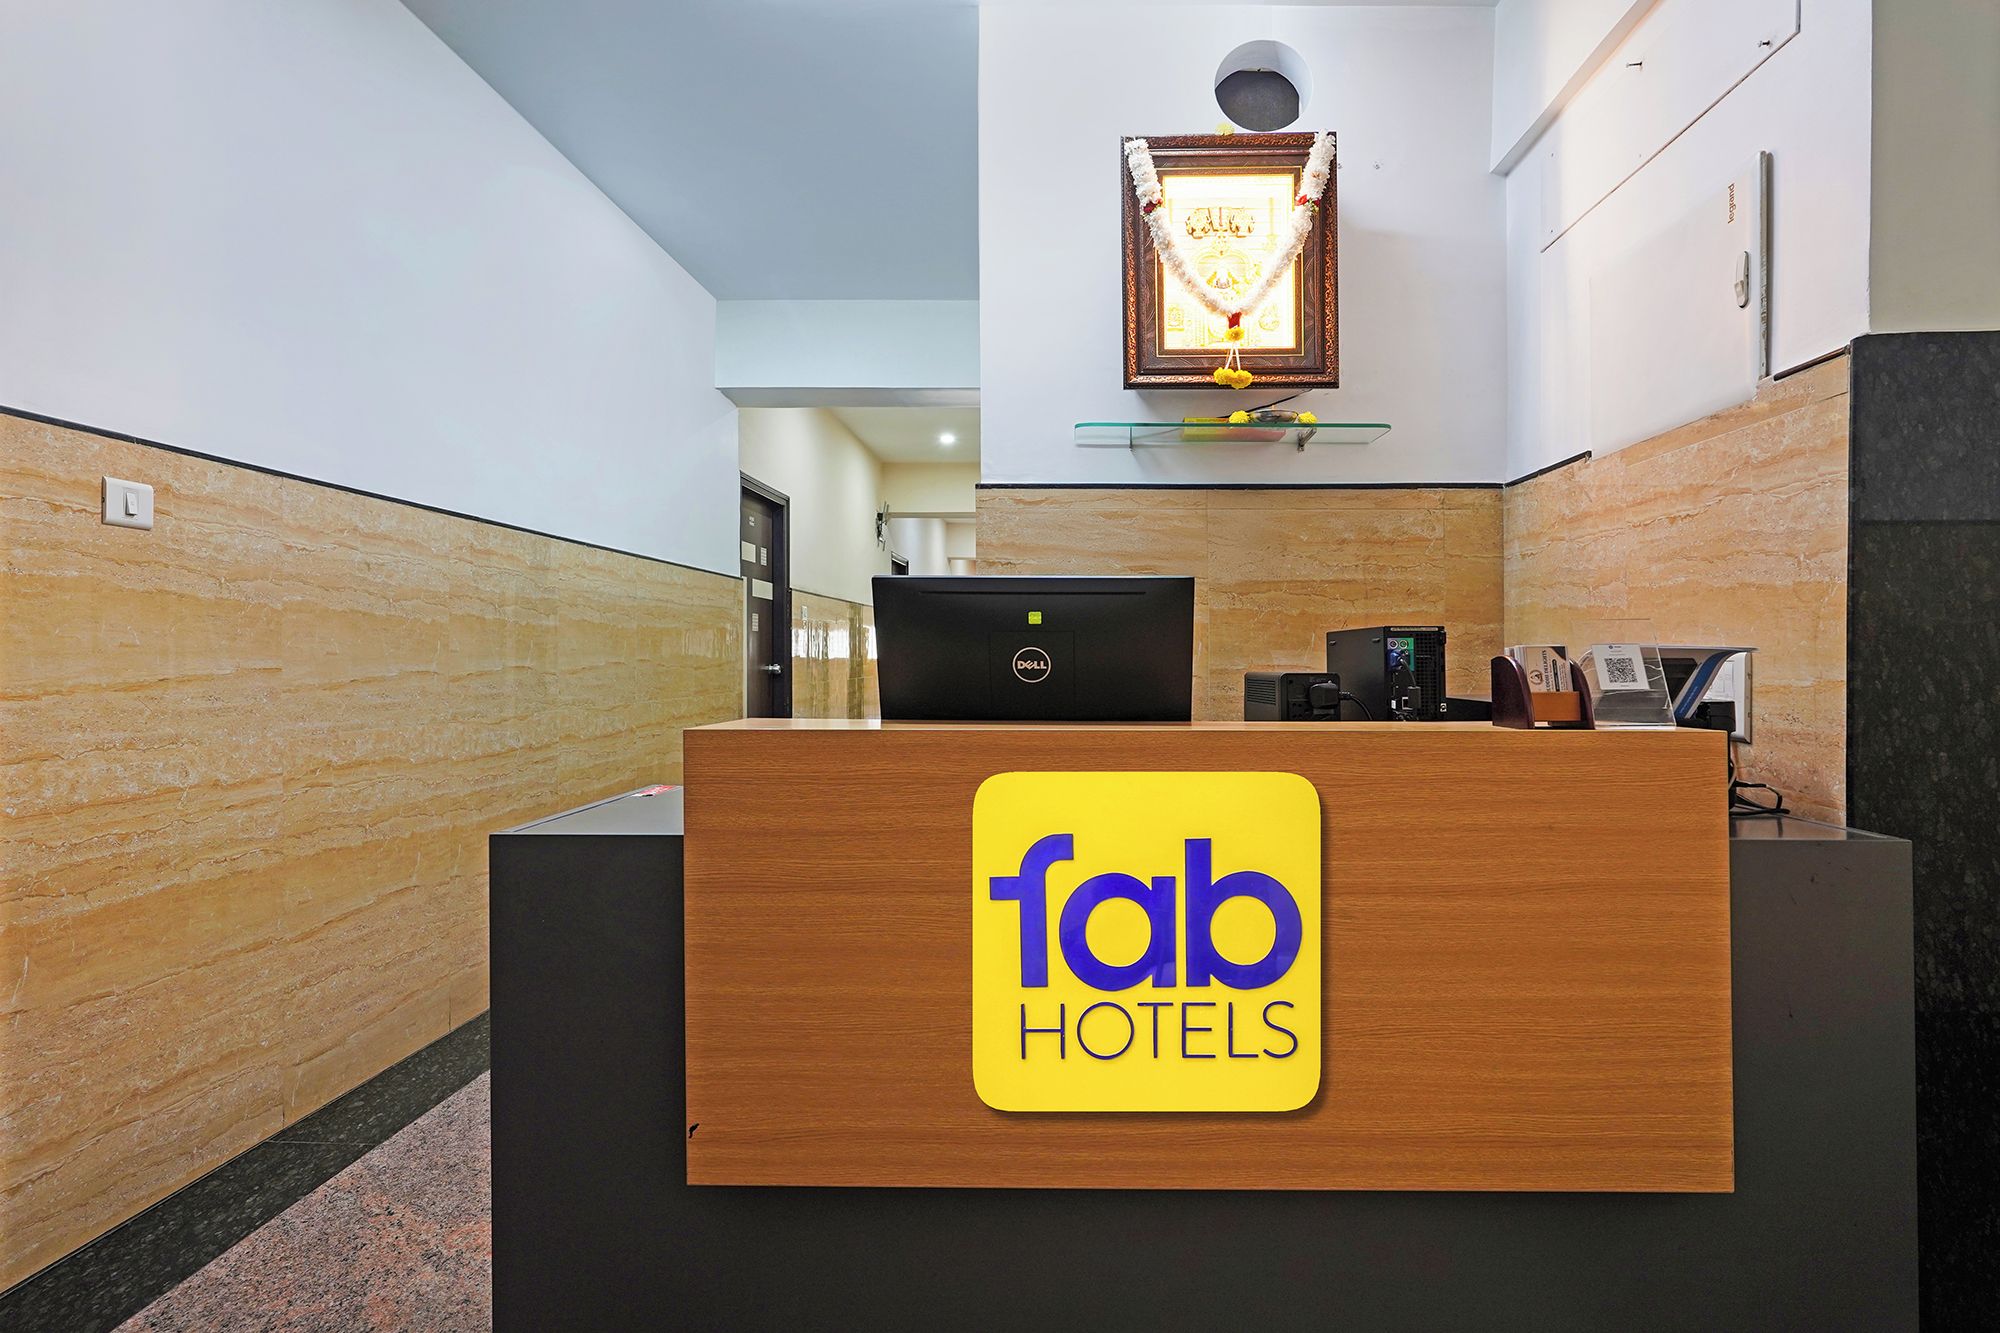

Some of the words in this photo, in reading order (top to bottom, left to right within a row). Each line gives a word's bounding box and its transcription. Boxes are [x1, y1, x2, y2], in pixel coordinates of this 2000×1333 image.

[1727, 183, 1737, 224] legrand
[1017, 660, 1047, 670] DELL
[989, 833, 1303, 991] fab
[1020, 1000, 1299, 1061] HOTELS
